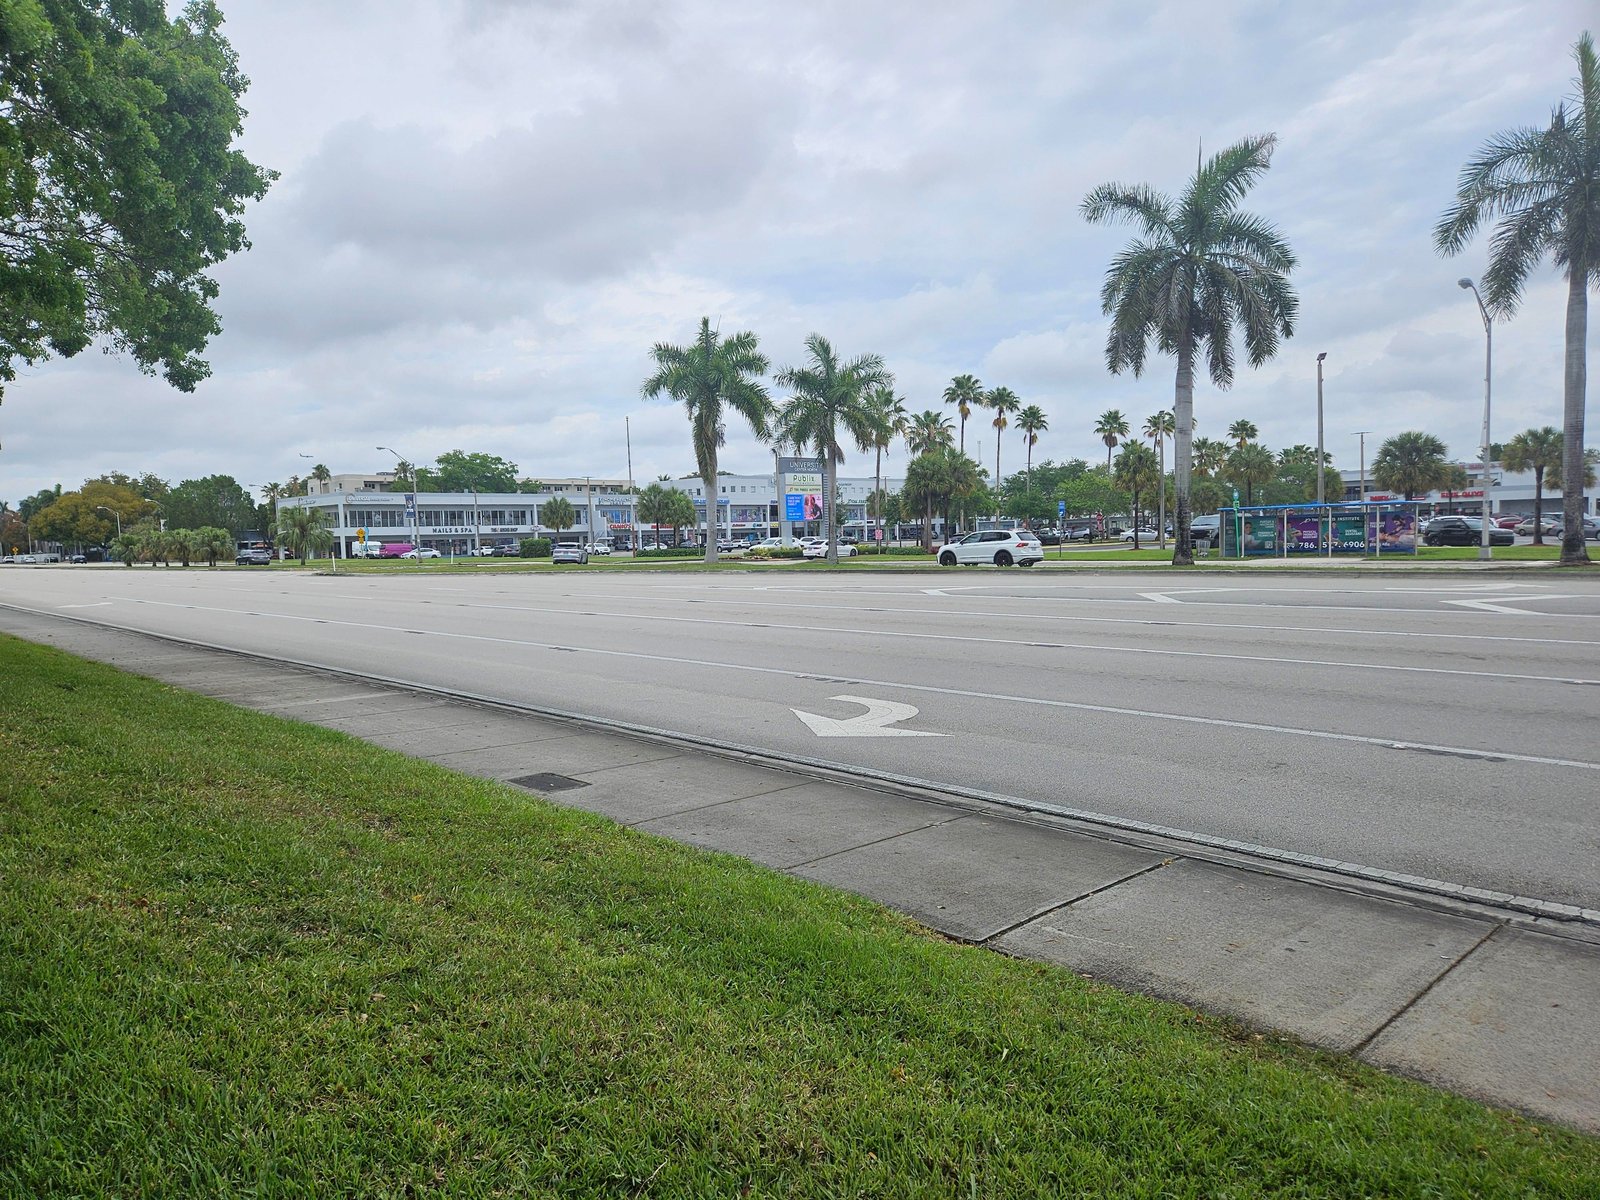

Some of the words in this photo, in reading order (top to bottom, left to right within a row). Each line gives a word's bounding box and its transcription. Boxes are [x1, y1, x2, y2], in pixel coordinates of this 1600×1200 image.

[793, 474, 814, 482] Publix
[1298, 541, 1317, 549] 786.
[1322, 541, 1341, 549] 57.
